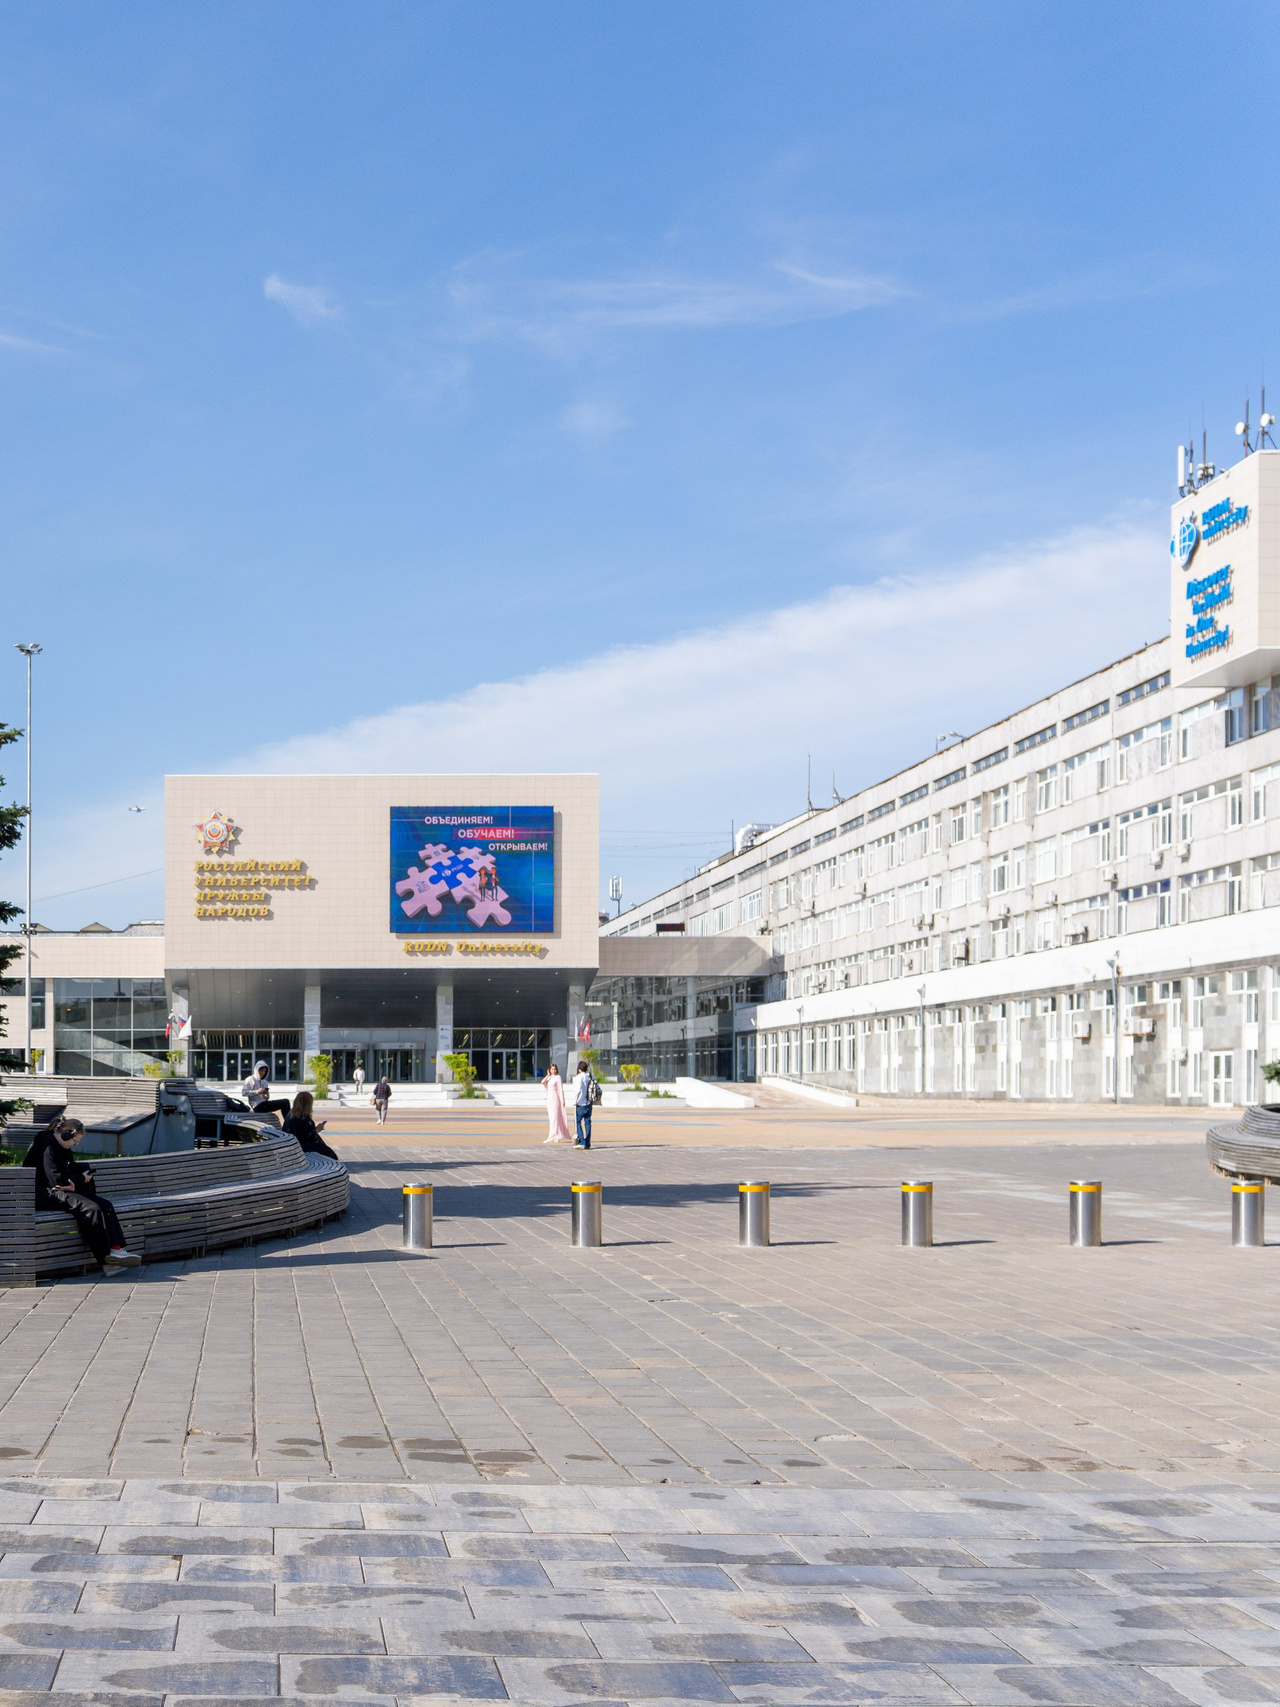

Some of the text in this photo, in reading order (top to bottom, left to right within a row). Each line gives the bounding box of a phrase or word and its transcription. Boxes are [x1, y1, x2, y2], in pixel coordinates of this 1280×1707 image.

[424, 816, 494, 825] ОБЪЕДИНЯЕМ!
[458, 829, 515, 838] ОБУЧАЕМ!
[488, 843, 548, 851] ОТКРЫВАЕМ!
[194, 859, 302, 871] РОССИЙСКИЙ
[194, 875, 312, 887] УНИВЕРСИТЕТ
[195, 890, 266, 901] ДРУЖБЫ
[194, 906, 269, 917] НАРОДОВ
[403, 941, 543, 955] RUDN University
